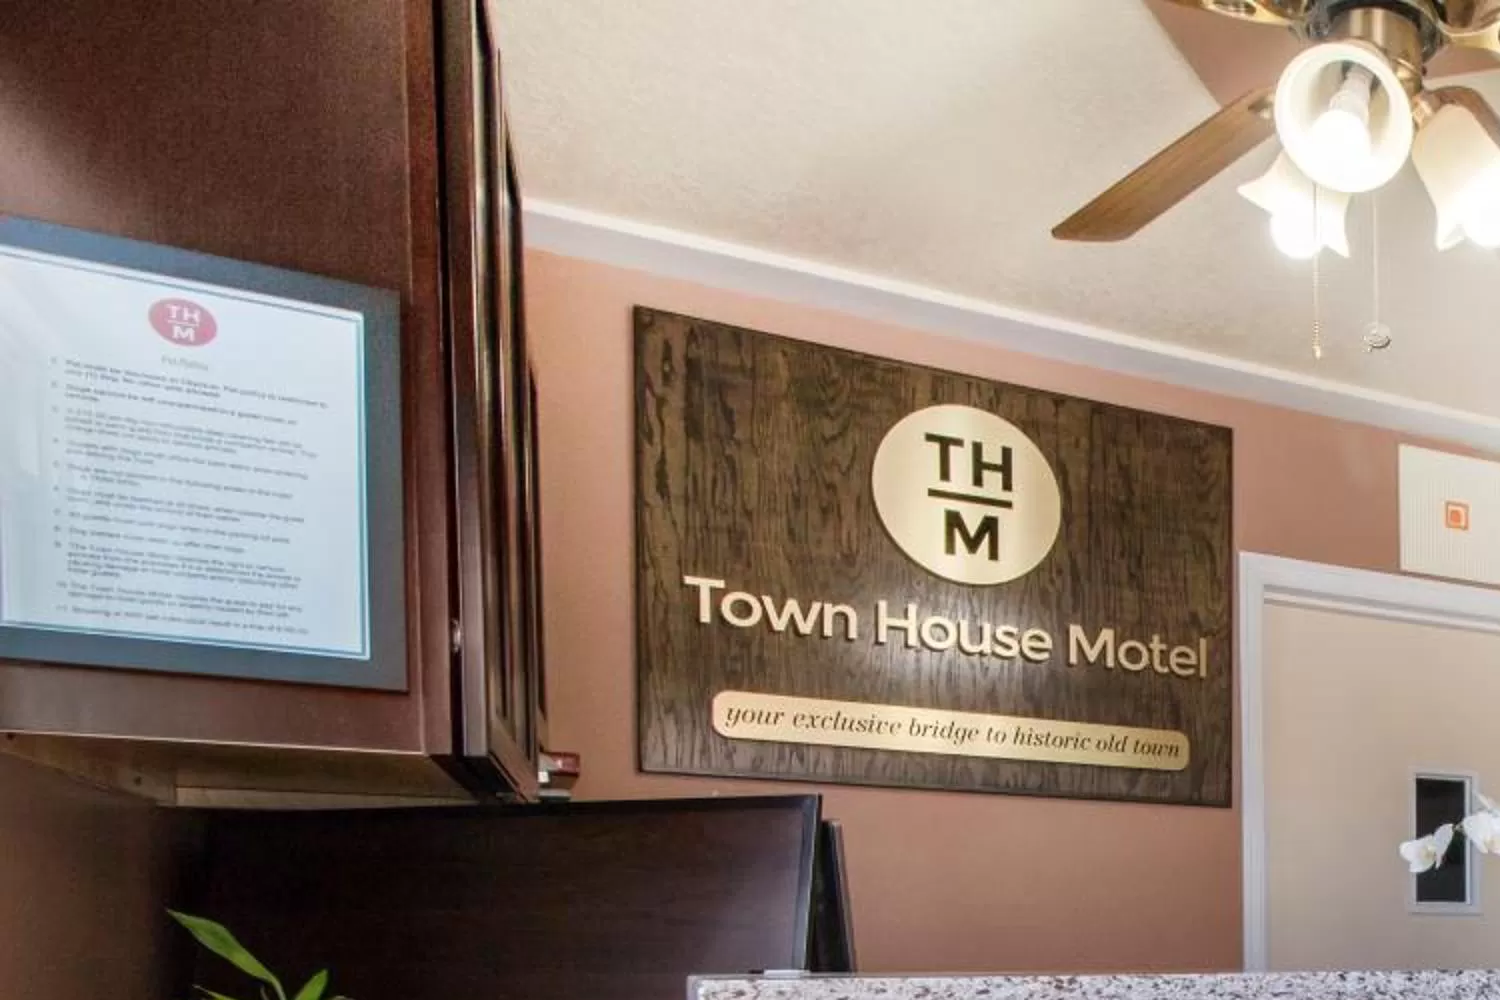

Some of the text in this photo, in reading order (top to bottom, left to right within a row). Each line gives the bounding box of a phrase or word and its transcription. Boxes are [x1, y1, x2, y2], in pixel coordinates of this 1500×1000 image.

[166, 304, 201, 323] TH
[172, 326, 196, 341] M
[925, 432, 1014, 492] TH
[944, 510, 999, 561] M
[684, 575, 1207, 678] Town House Motel
[725, 706, 1180, 759] your exclusive bridge to historic old town
